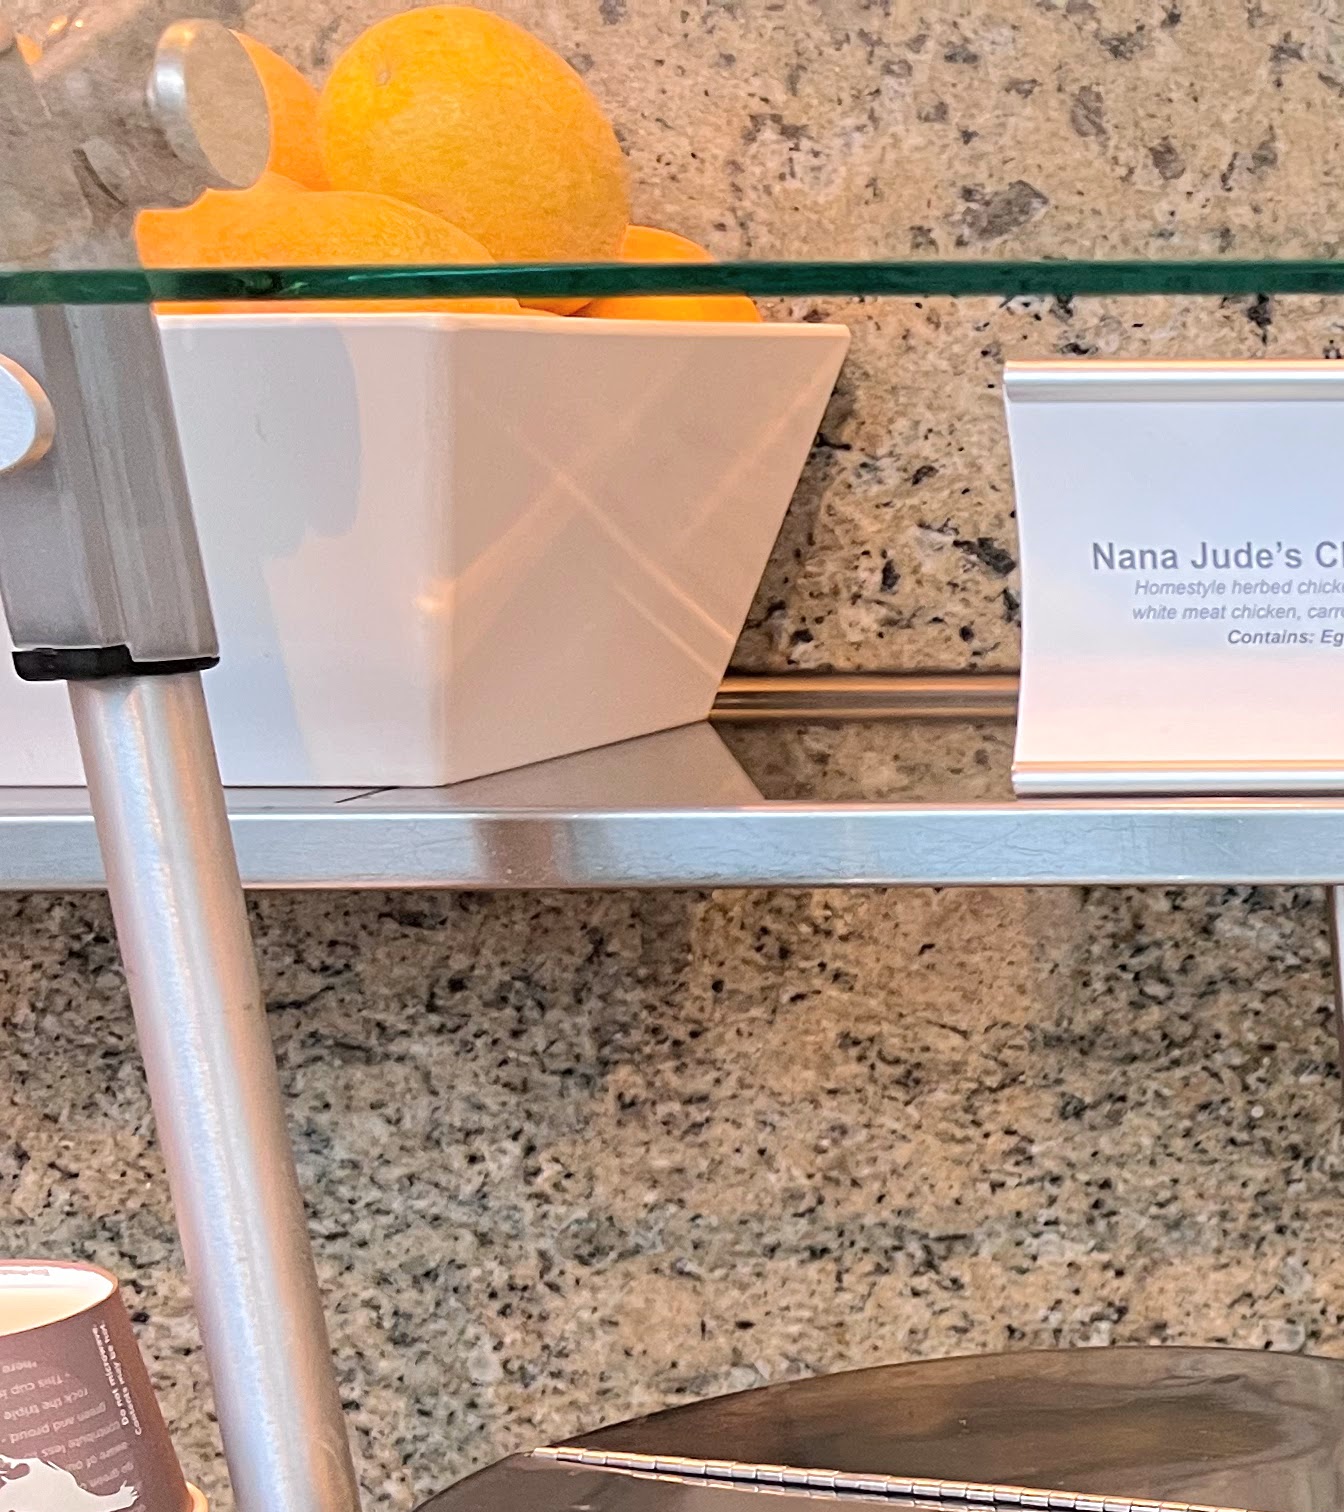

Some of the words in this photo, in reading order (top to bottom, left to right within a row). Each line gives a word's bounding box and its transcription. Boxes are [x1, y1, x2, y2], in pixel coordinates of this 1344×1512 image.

[1092, 541, 1179, 571] Nana
[1190, 540, 1303, 571] Jude's
[1134, 579, 1226, 598] Homestyle
[1231, 578, 1294, 595] herbed
[1132, 604, 1178, 620] white
[1181, 604, 1227, 621] meat
[1230, 603, 1302, 622] chicken,
[1227, 628, 1316, 645] Contains:
[120, 1409, 130, 1425] Do
[9, 1423, 50, 1444] proud
